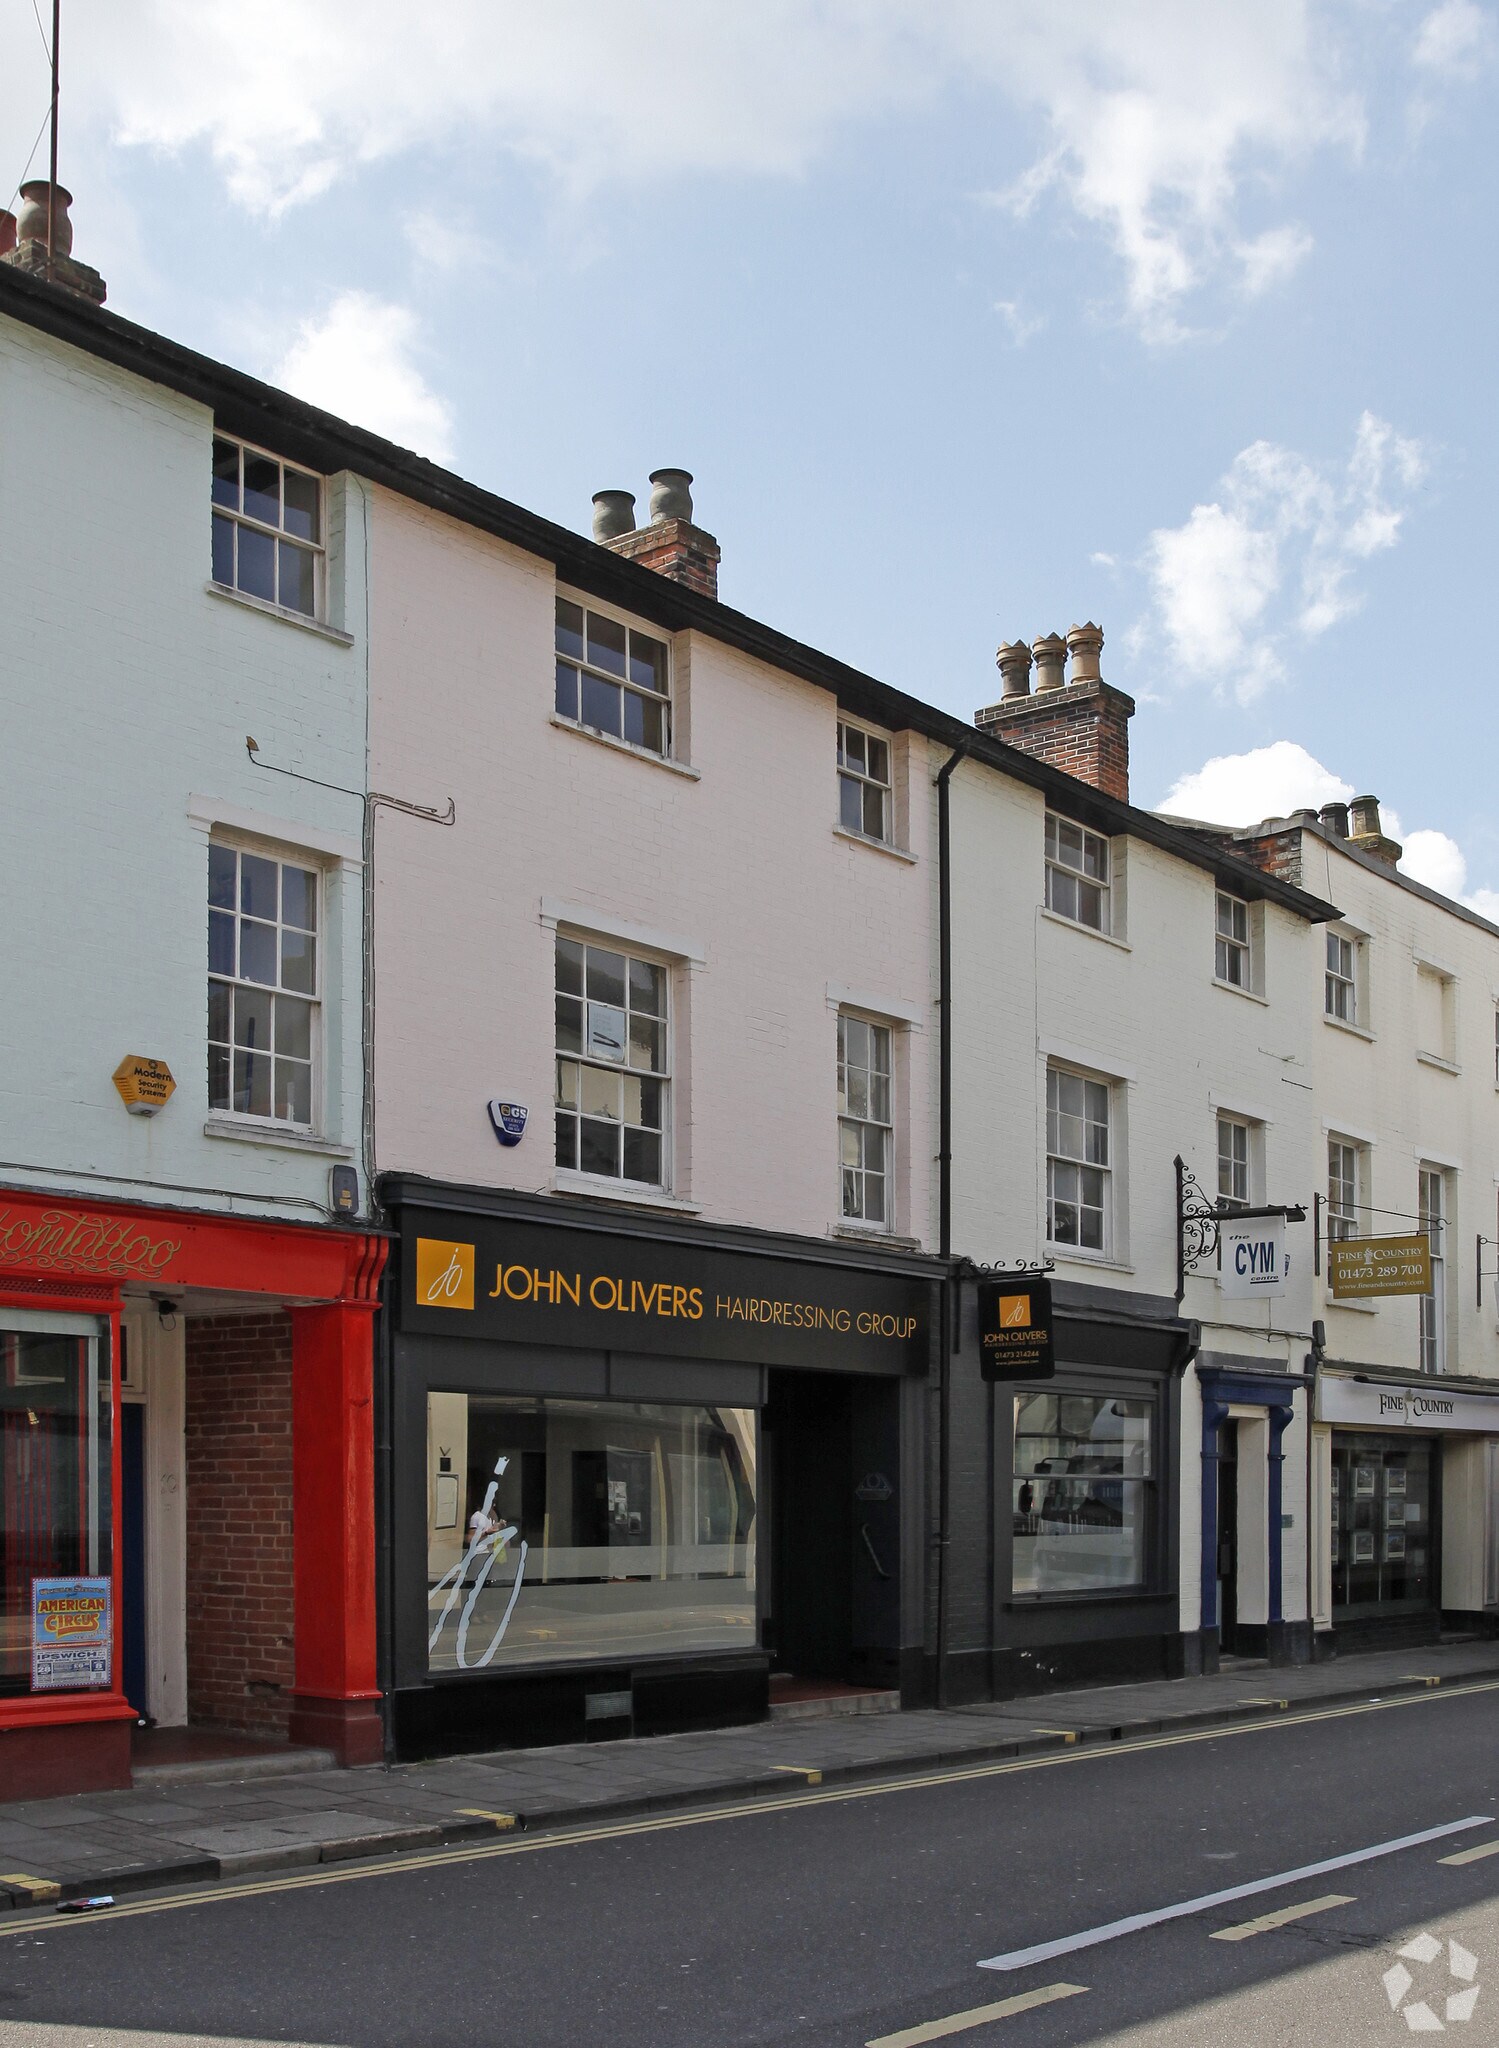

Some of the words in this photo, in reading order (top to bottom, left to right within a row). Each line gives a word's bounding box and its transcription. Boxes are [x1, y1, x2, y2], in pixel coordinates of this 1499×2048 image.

[134, 1066, 171, 1082] Modern
[138, 1079, 167, 1091] Security
[138, 1087, 166, 1098] Systems
[1235, 1241, 1274, 1275] CYM
[1337, 1252, 1363, 1263] FINE
[1374, 1247, 1423, 1260] COUNTRY
[1339, 1267, 1374, 1279] 01473
[1377, 1266, 1398, 1277] 289
[1401, 1264, 1423, 1276] 700
[1338, 1279, 1425, 1290] www.fineandcountry.com
[489, 1263, 581, 1306] JOHN
[589, 1276, 703, 1319] OLIVERS
[716, 1295, 851, 1332] HAIRDRESSING
[856, 1312, 917, 1338] GROUP
[983, 1333, 1009, 1343] JOHN
[1010, 1330, 1047, 1341] OLIVERS
[1379, 1393, 1403, 1414] FINE
[1413, 1396, 1454, 1416] COUNTRY
[38, 1598, 105, 1613] AMERICAN
[44, 1613, 99, 1637] CIRCUS
[37, 1651, 97, 1660] IPSWICH
